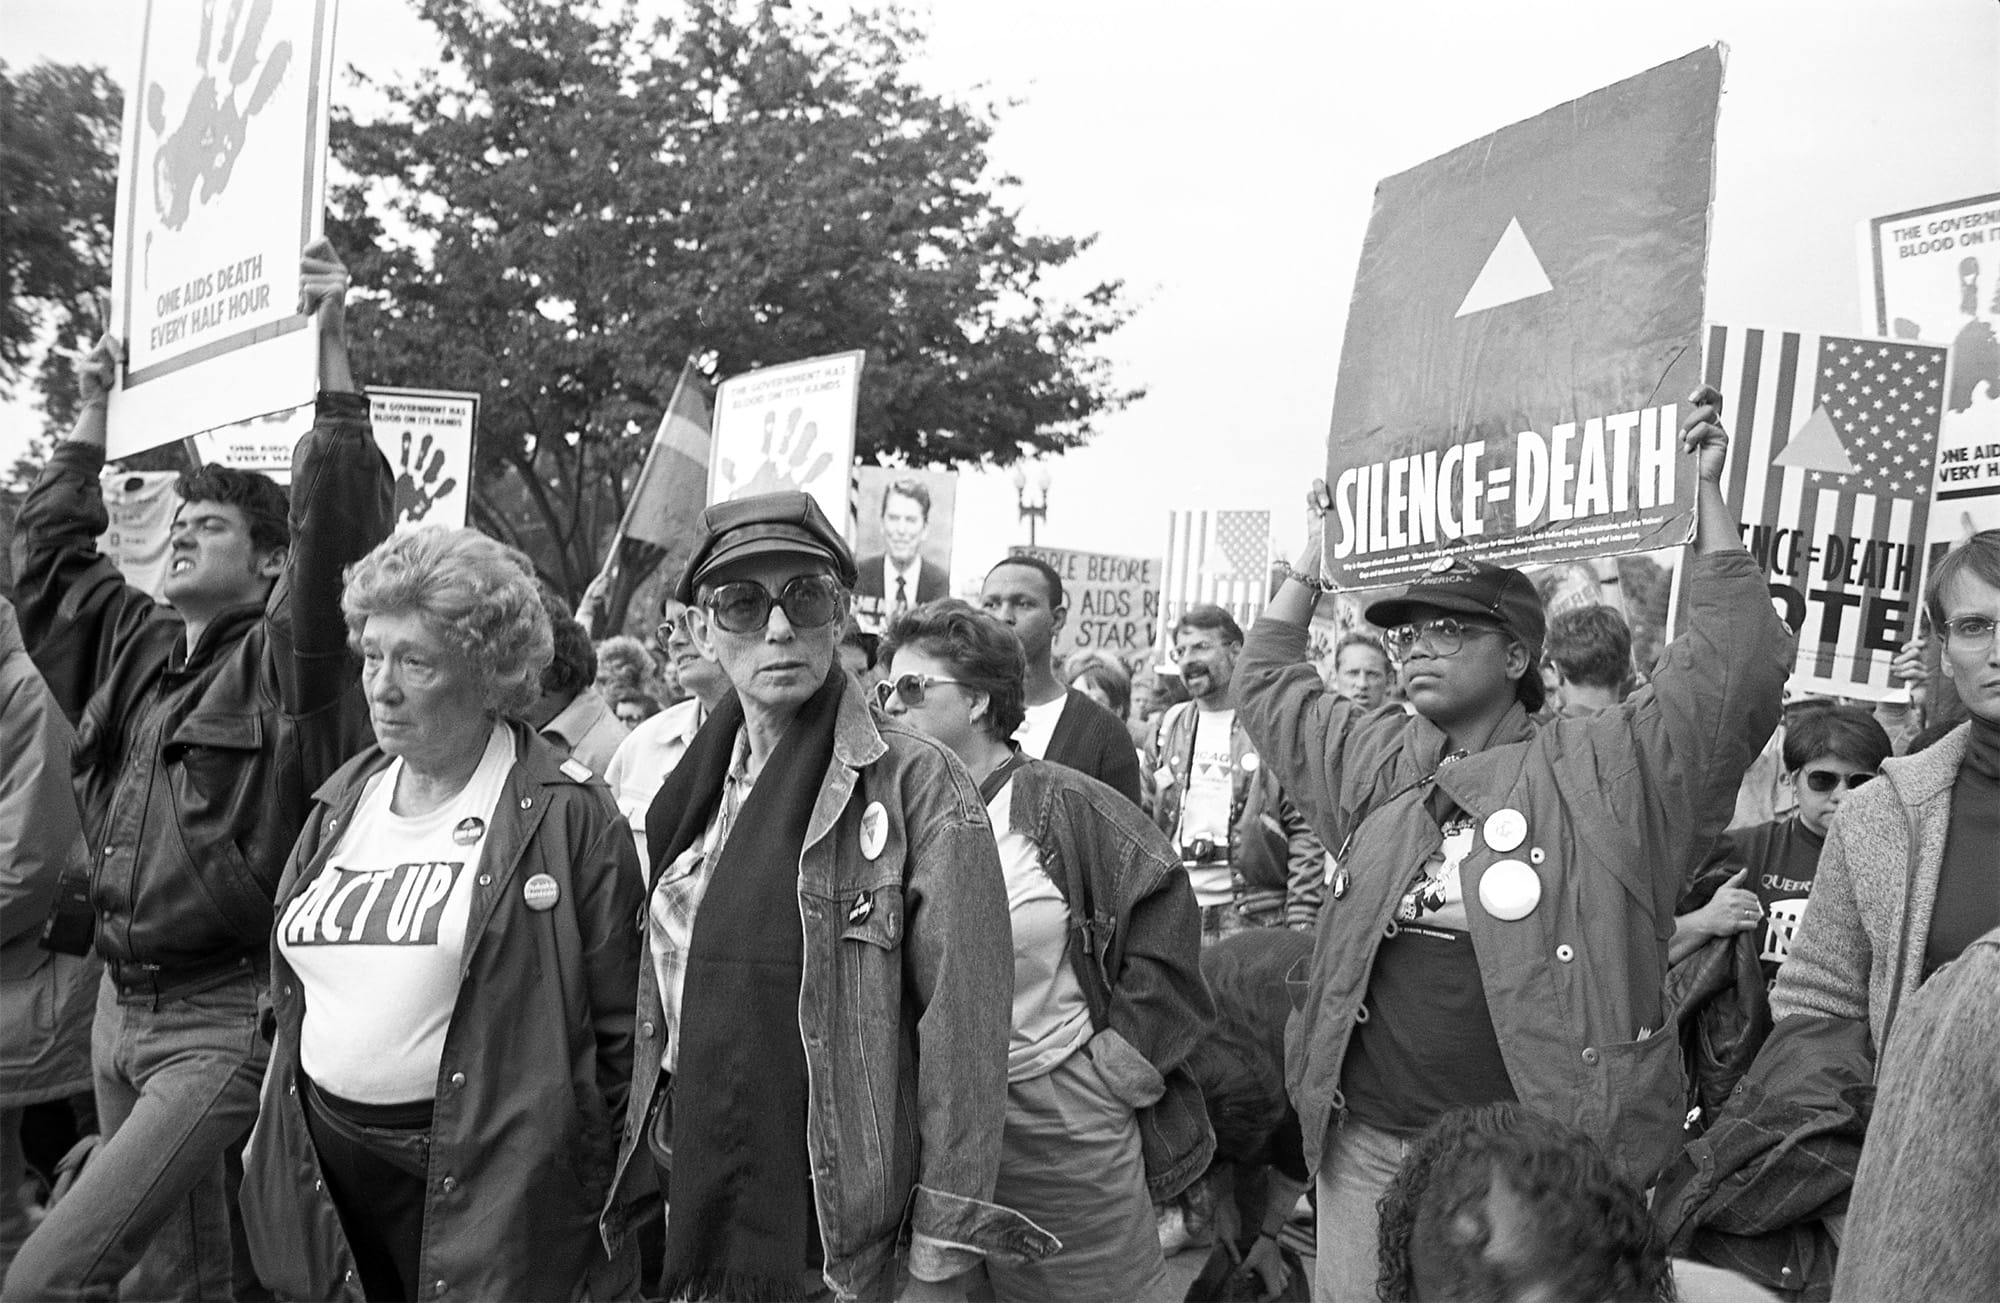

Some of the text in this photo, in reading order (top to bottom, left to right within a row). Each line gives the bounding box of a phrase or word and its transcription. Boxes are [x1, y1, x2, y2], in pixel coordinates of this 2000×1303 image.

[1893, 225, 1921, 242] THE
[1899, 237, 1954, 258] BLOOD
[1960, 231, 1983, 247] ON
[157, 253, 263, 318] ONE AIDS DEATH
[150, 283, 270, 351] EVERY HALF HOUR
[373, 413, 402, 423] BLOOD
[433, 417, 463, 427] HANDS
[388, 402, 447, 414] GOVERNMENT
[448, 406, 466, 416] HAS
[1088, 555, 1151, 583] BEFORE
[1080, 589, 1131, 617] AIDS
[1075, 620, 1137, 649] STAR
[288, 863, 453, 943] ACT UP
